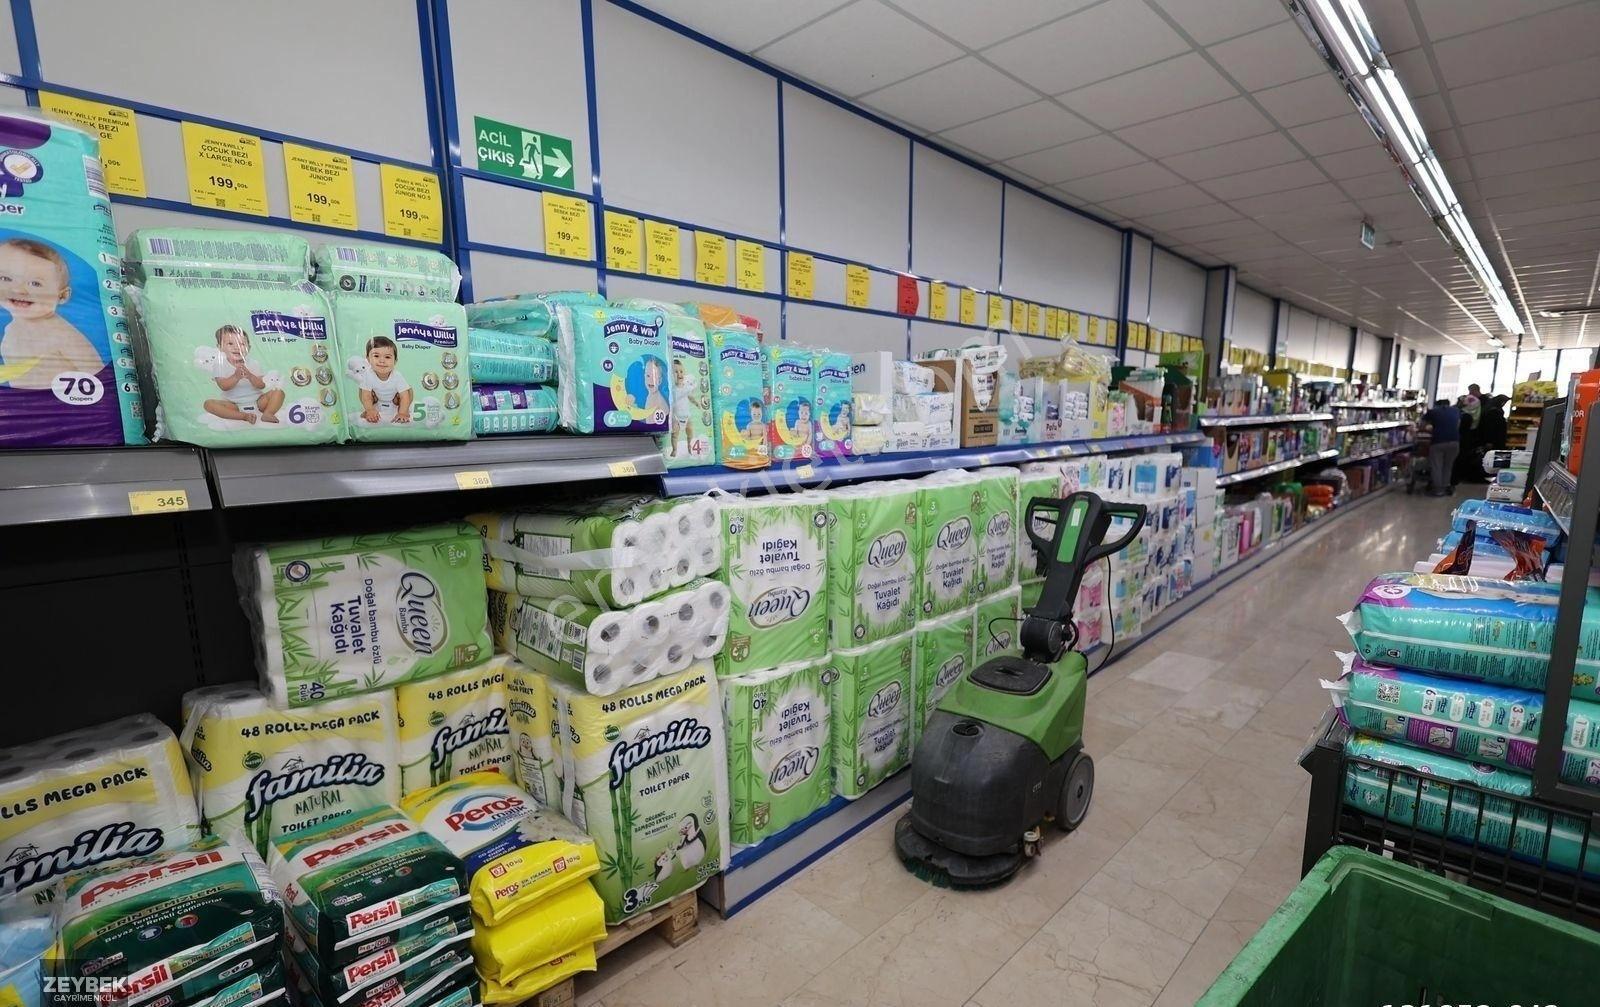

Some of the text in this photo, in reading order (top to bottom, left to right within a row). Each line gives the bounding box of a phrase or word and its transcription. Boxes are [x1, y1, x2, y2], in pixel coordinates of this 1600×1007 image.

[74, 112, 96, 122] WILLY
[97, 116, 130, 127] PREMIUM
[478, 129, 512, 147] ACİL
[201, 144, 230, 155] ÇOCUK
[205, 153, 233, 163] LARGE
[478, 146, 515, 167] ÇIKIŞ
[300, 164, 323, 174] BEBEK
[308, 173, 334, 183] JUNIOR
[394, 183, 417, 192] ÇOCUK
[395, 190, 417, 199] JUNIOR
[111, 306, 118, 316] 3
[255, 317, 324, 332] Jenny & Willy
[397, 325, 456, 340] Jenny Willy
[606, 323, 657, 337] Jenny & Willy
[628, 338, 661, 347] Baby Diaper
[59, 377, 96, 396] 70
[124, 382, 131, 393] 6
[288, 404, 306, 424] 6
[413, 403, 427, 422] 5
[607, 412, 616, 426] 6
[655, 411, 665, 421] 30
[692, 439, 702, 455] 4
[156, 496, 185, 507] 345
[729, 523, 744, 535] 40
[937, 522, 972, 550] Queen
[455, 549, 467, 559] 3
[762, 538, 798, 552] Kağıdı
[867, 538, 907, 568] Queen
[759, 550, 800, 564] Tuvalet
[765, 564, 790, 576] bambu
[942, 567, 965, 580] Tuvalet
[874, 586, 902, 600] Tuvalet
[942, 577, 963, 590] Kağıdı
[400, 571, 436, 656] Queen
[749, 589, 811, 619] Queen
[876, 598, 900, 611] Kağıdı
[330, 602, 349, 654] Kağıdı
[347, 595, 364, 655] Tuvalet
[364, 578, 382, 665] Doğal bambu özlü
[399, 607, 408, 635] Bambu
[936, 658, 964, 687] Queen
[310, 681, 325, 700] 40
[428, 690, 444, 701] 48
[446, 681, 480, 698] ROLLS
[601, 675, 707, 714] 48 ROLLS MEGA PACK
[509, 699, 537, 719] familia
[753, 698, 767, 710] 40
[781, 701, 811, 719] Kağıdı
[868, 686, 902, 719] Queen
[240, 726, 261, 738] 48
[310, 717, 345, 732] MEGA
[348, 710, 381, 726] PACK
[778, 712, 813, 733] Tuvalet
[873, 729, 897, 746] Tuvalet
[468, 737, 505, 760] NATURAL
[608, 717, 712, 790] familia
[459, 754, 513, 776] TOILET PAPER
[646, 753, 682, 780] NATURAL
[769, 746, 820, 786] Queen
[0, 766, 148, 820] LLS MEGA PACK
[244, 752, 386, 824] familia
[639, 772, 691, 798] TOILET PAPER
[293, 789, 344, 816] NATURAL
[445, 796, 524, 832] Peros
[491, 804, 528, 821] matik
[280, 818, 320, 834] TOILET
[303, 822, 411, 868] Persil
[80, 851, 223, 908] Persil
[494, 882, 520, 900] Peros
[625, 888, 638, 913] 3
[96, 885, 226, 936] DERİN TEMİZLEME
[104, 896, 223, 943] Beyaz Renkli Çamaşırlar
[132, 899, 198, 926] Temiz Ferah
[349, 899, 399, 930] Persil
[347, 948, 397, 984] Persil
